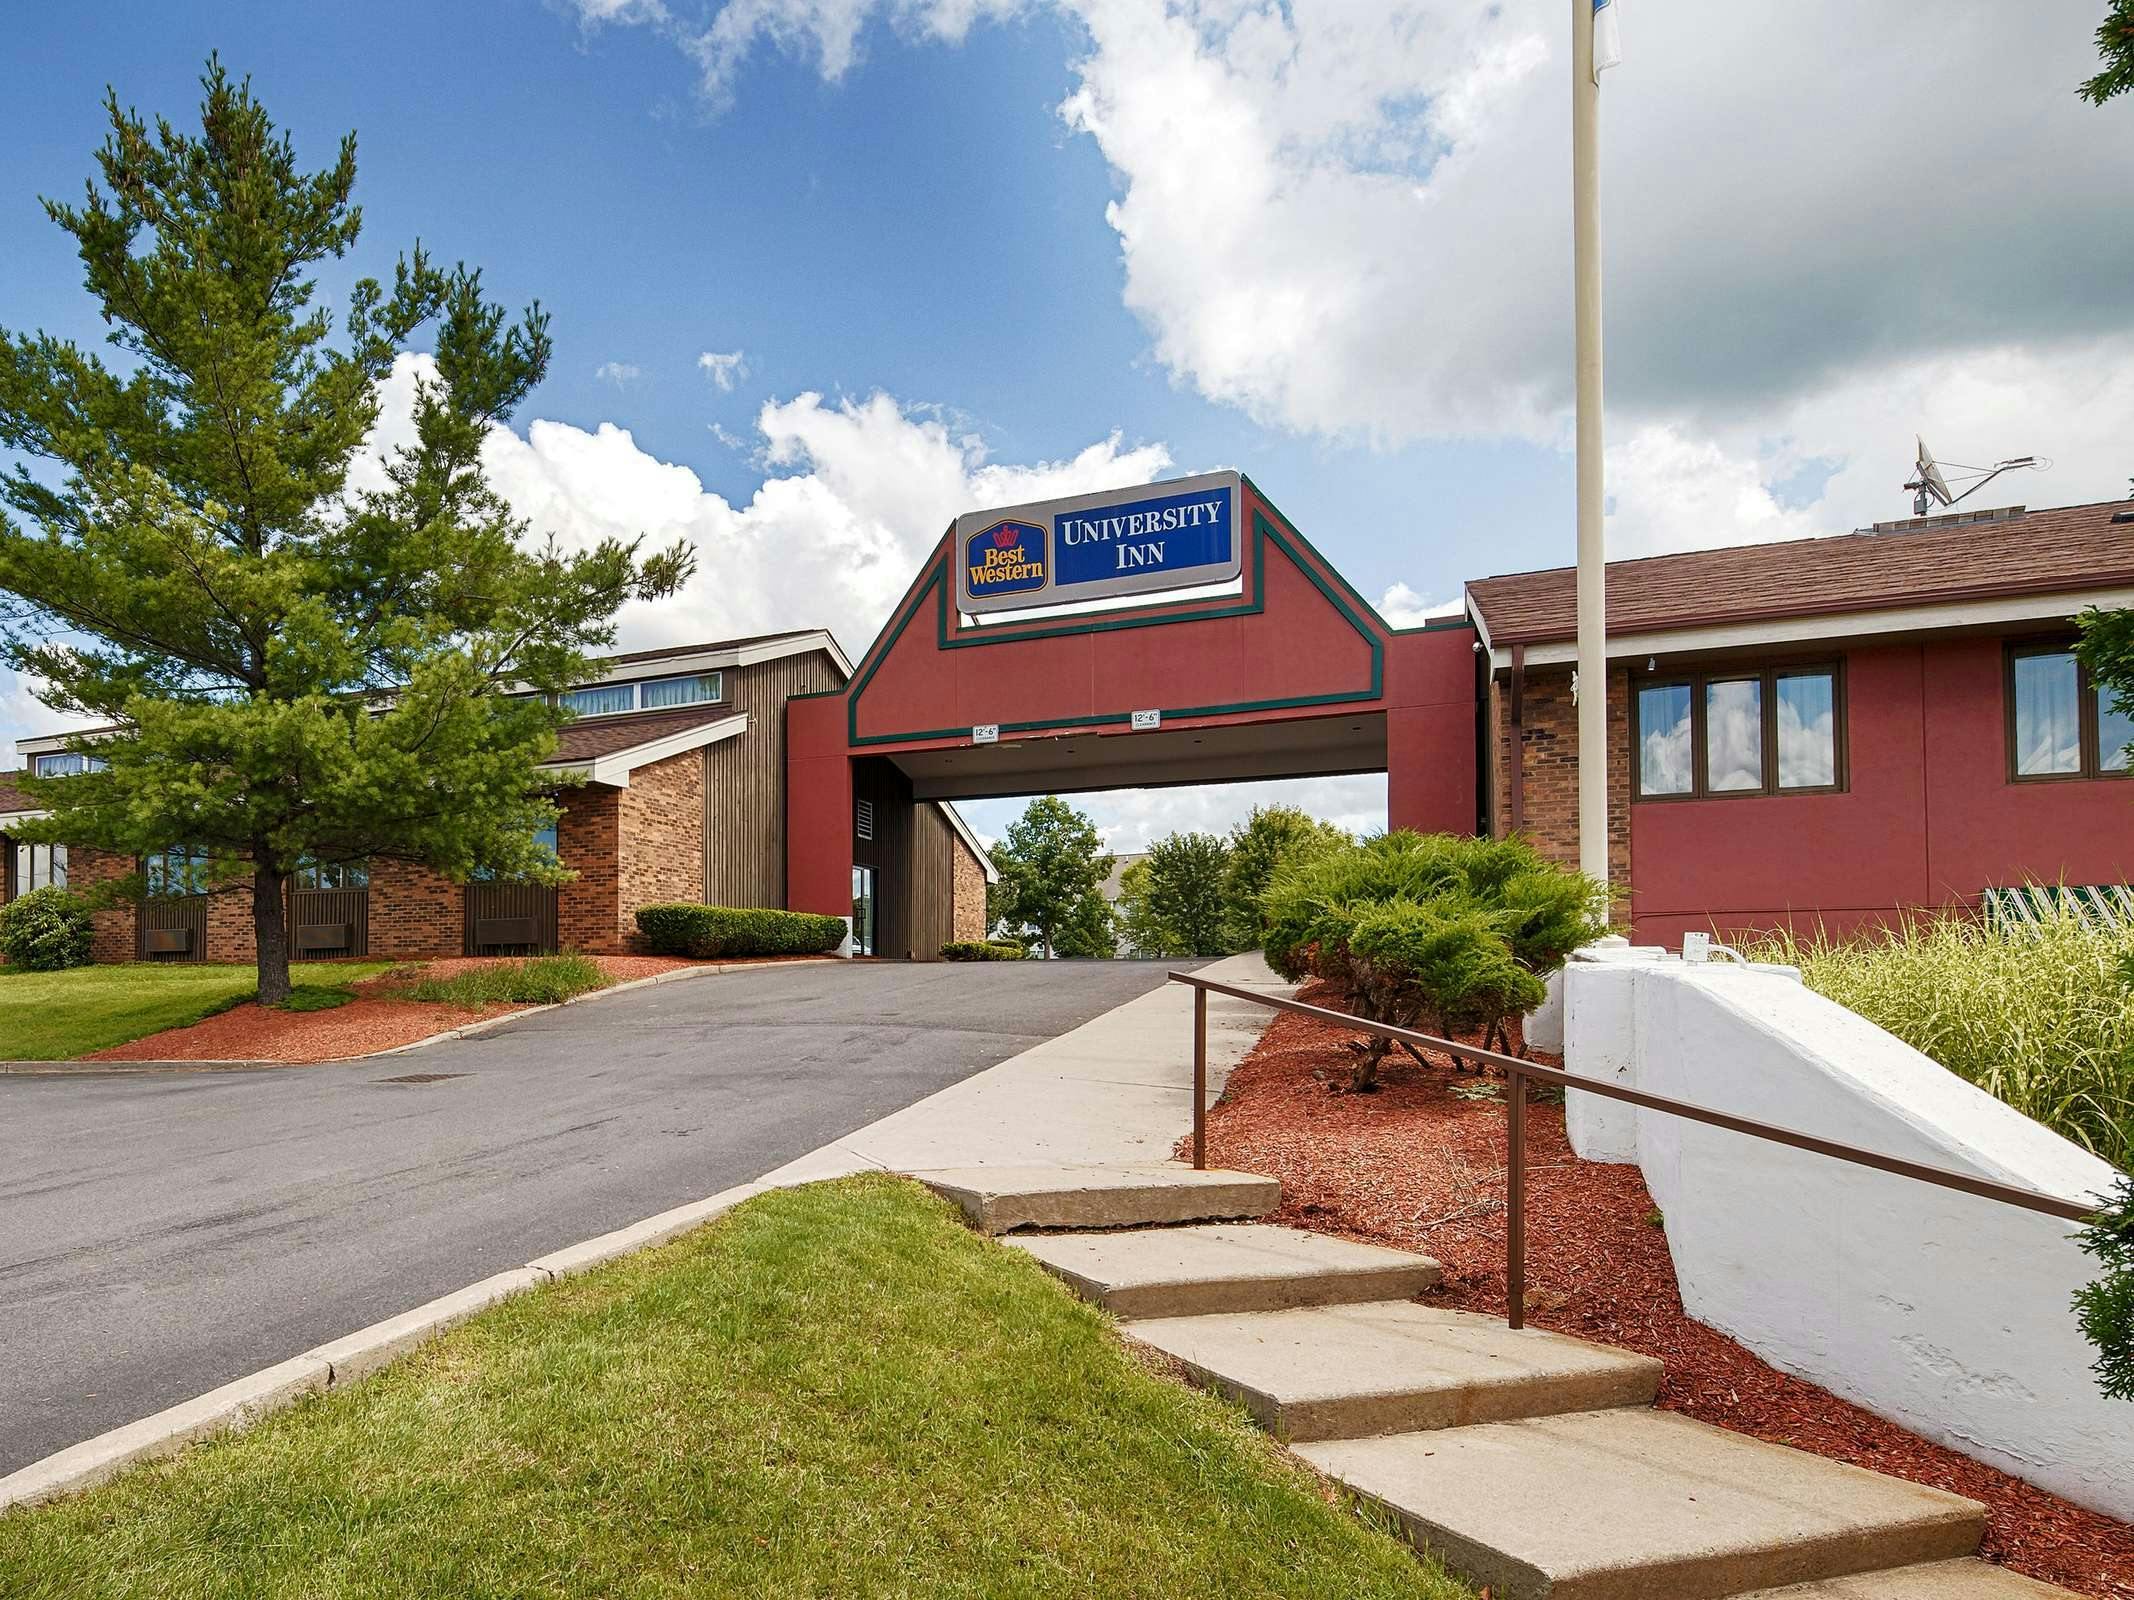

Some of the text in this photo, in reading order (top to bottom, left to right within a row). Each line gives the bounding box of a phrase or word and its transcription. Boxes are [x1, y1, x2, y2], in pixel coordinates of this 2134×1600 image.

[1062, 501, 1223, 546] UNIVERSITY
[984, 544, 1026, 567] Best
[1116, 541, 1166, 569] INN
[970, 562, 1043, 585] Western
